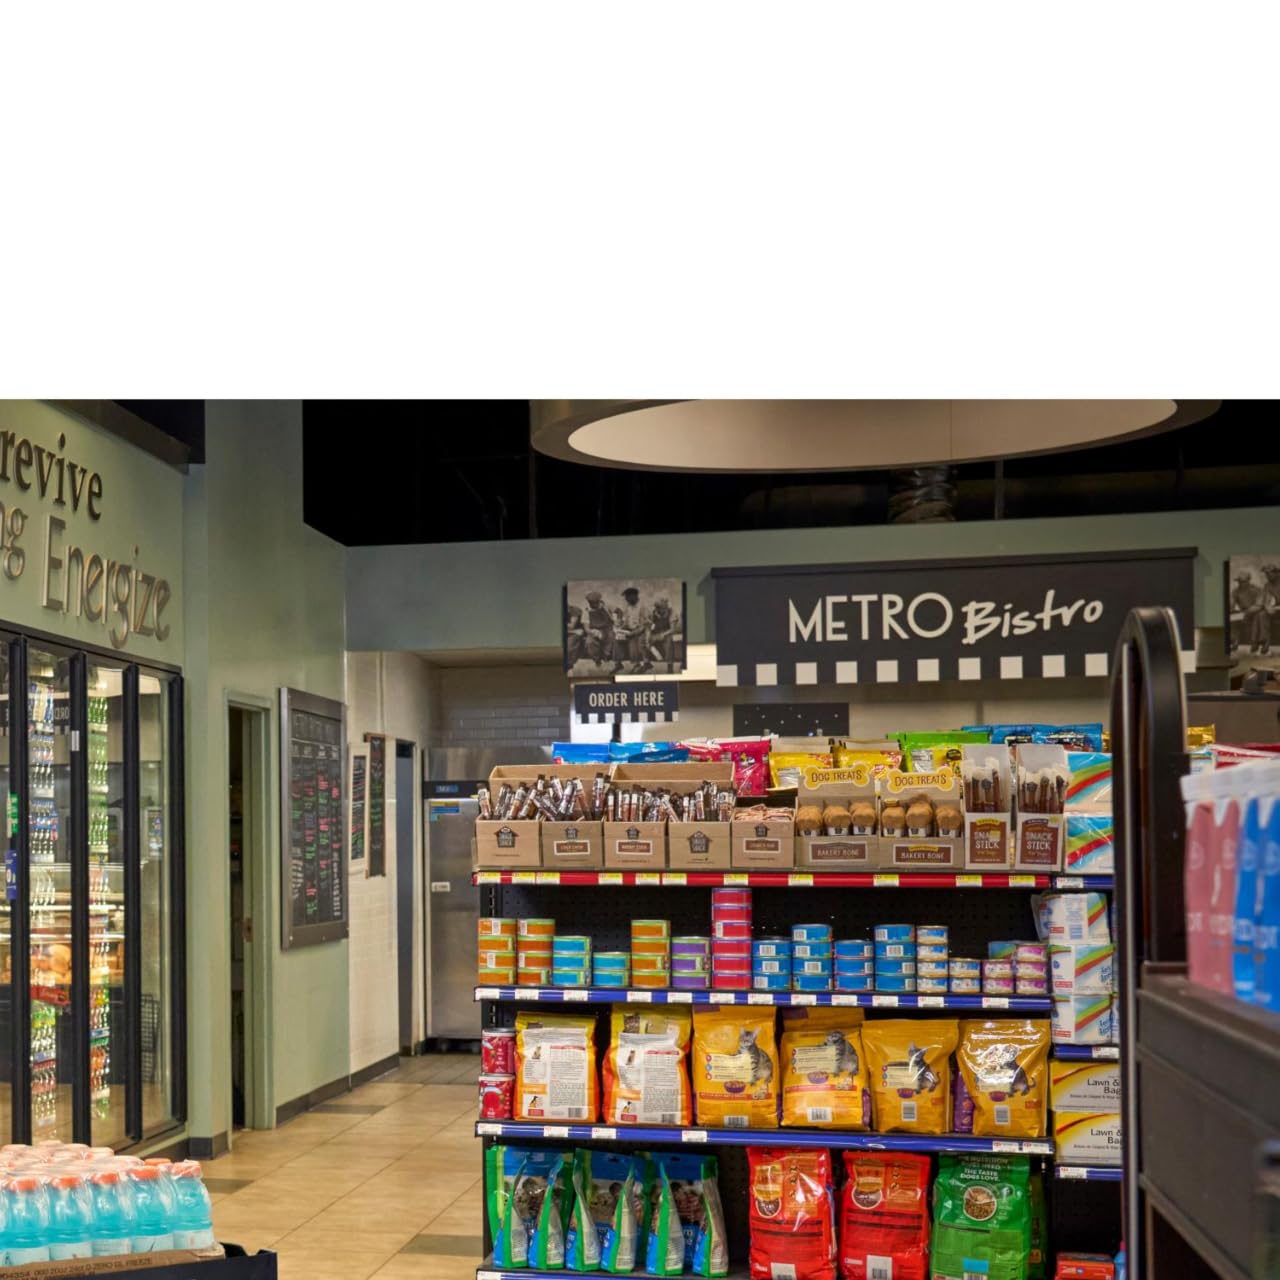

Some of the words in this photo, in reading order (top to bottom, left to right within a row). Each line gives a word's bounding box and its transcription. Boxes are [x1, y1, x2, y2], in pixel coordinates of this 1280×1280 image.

[41, 514, 171, 649] Energize
[788, 591, 953, 644] METRO
[961, 588, 1104, 646] Bistro
[589, 692, 628, 707] ORDER
[634, 691, 664, 706] HERE
[812, 772, 830, 783] DOG
[833, 769, 862, 781] TREATS
[895, 776, 913, 787] DOG
[917, 773, 946, 785] TREATS
[1025, 832, 1053, 840] SNACK
[976, 840, 999, 849] STICK
[1026, 841, 1051, 849] STICK
[817, 849, 841, 857] BAKERY
[900, 851, 925, 860] BAKERY
[928, 852, 944, 860] BONE
[1087, 1078, 1109, 1086] Lawn
[1091, 1128, 1113, 1136] Lawn
